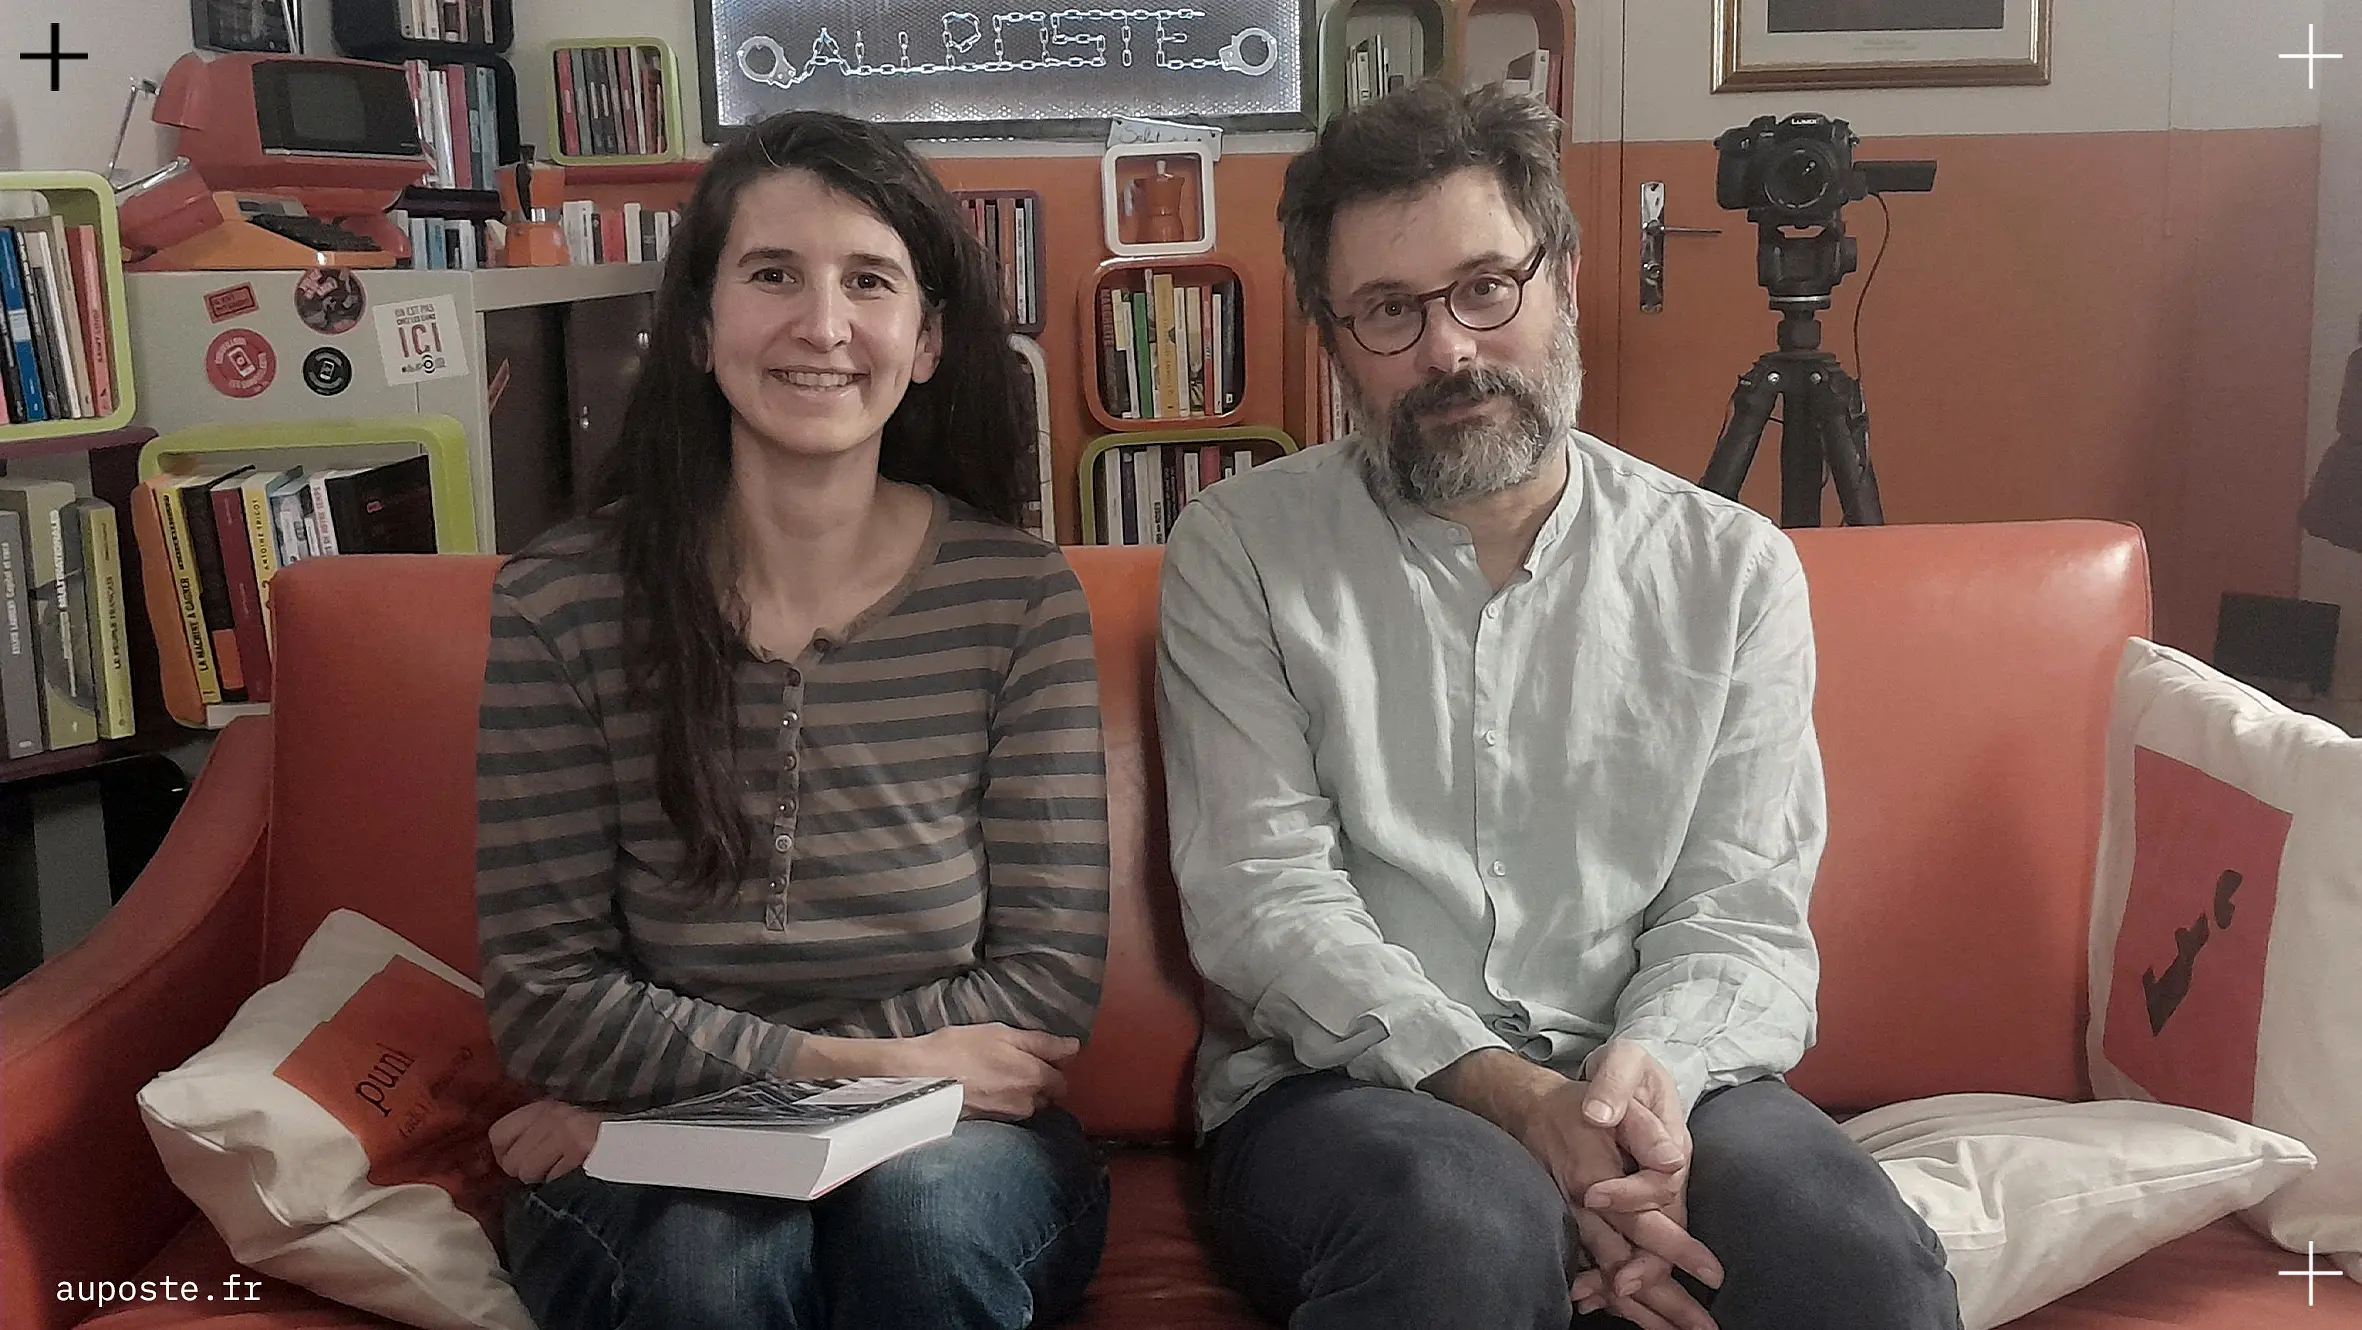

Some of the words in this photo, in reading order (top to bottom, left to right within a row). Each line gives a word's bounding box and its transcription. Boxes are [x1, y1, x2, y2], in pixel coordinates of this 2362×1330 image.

[942, 8, 1206, 70] POSTE
[398, 322, 442, 358] ICI
[258, 533, 270, 571] ANTOINE
[180, 577, 195, 611] GAGNER
[191, 621, 206, 659] MACHINE
[198, 659, 208, 671] LA
